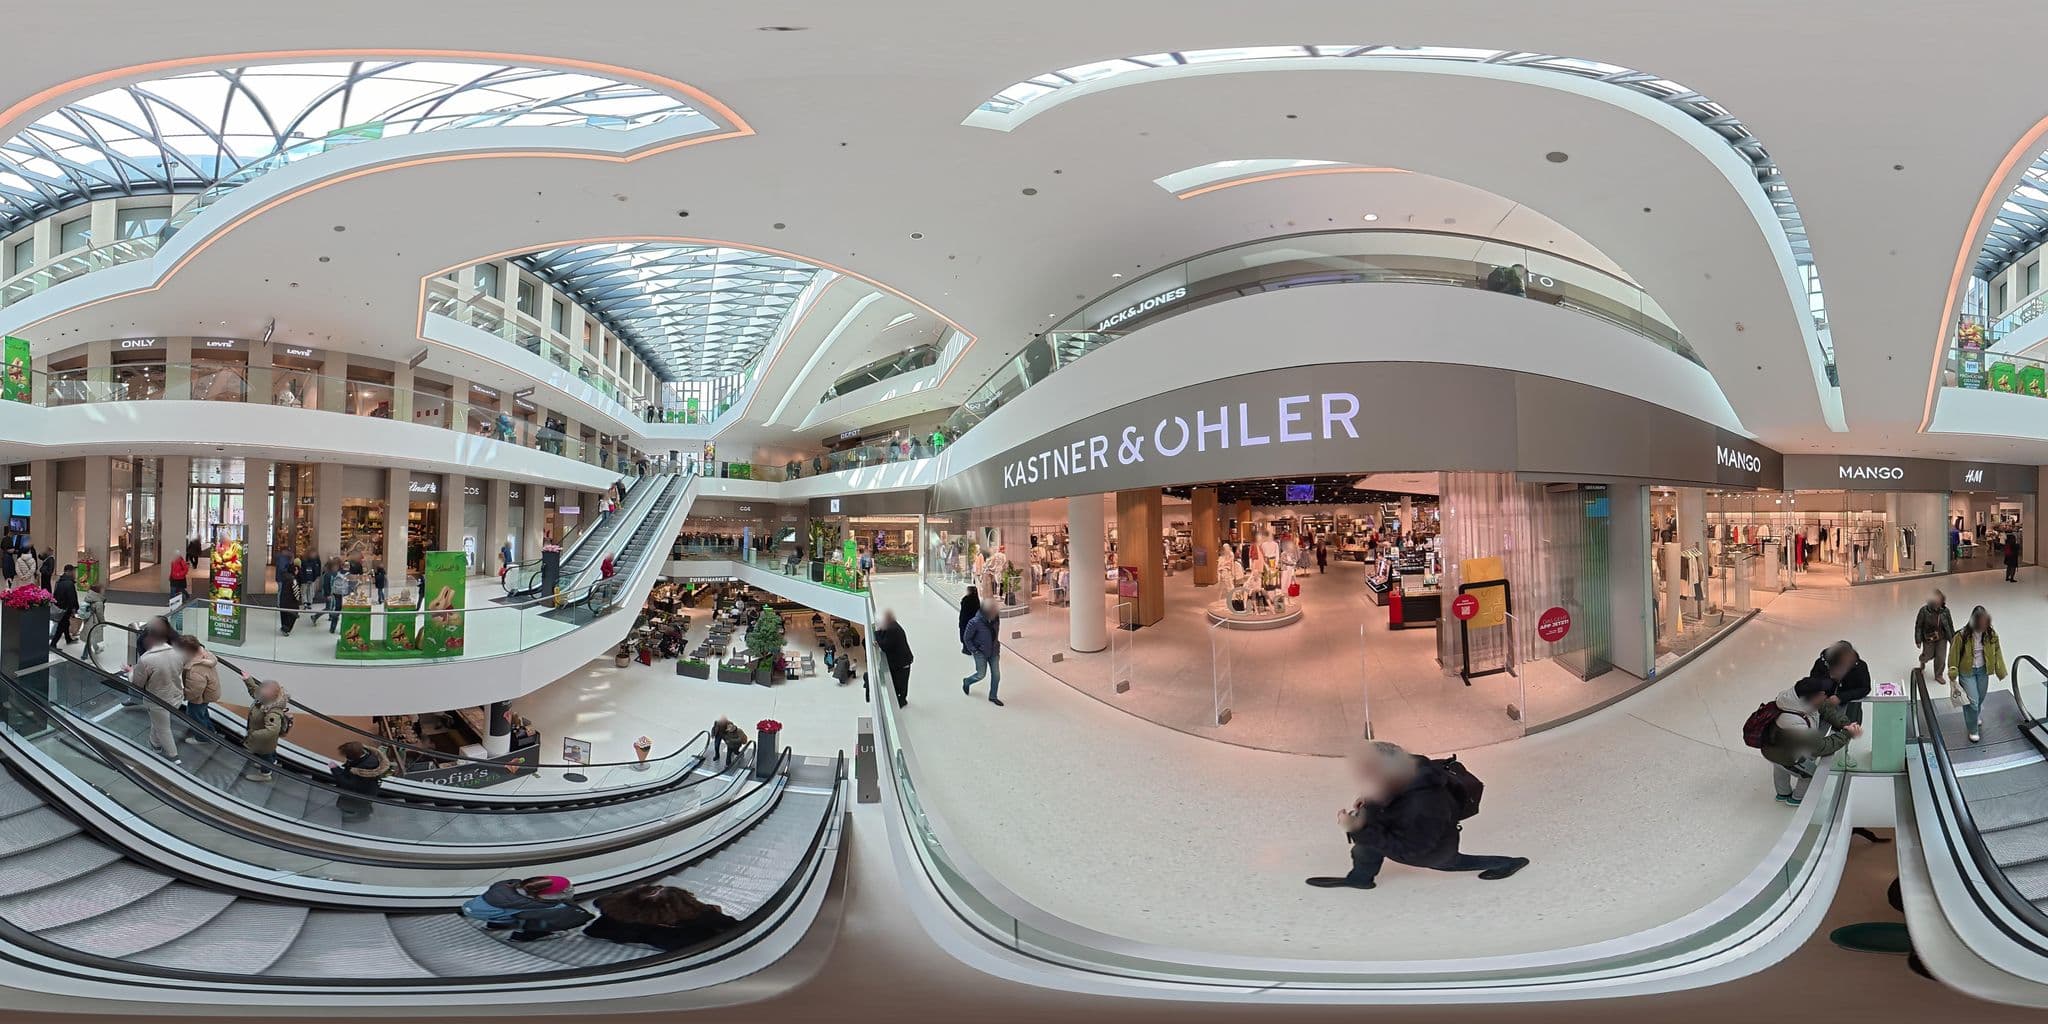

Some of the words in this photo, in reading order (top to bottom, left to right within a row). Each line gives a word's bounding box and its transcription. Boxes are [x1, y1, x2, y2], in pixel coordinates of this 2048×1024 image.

[1097, 287, 1187, 332] JACK&JONES
[121, 339, 155, 348] ONLY
[1003, 435, 1109, 489] KASTNER
[1117, 426, 1145, 465] &
[1717, 445, 1761, 473] MANGO
[1839, 465, 1904, 480] MANGO
[509, 490, 519, 499] OS
